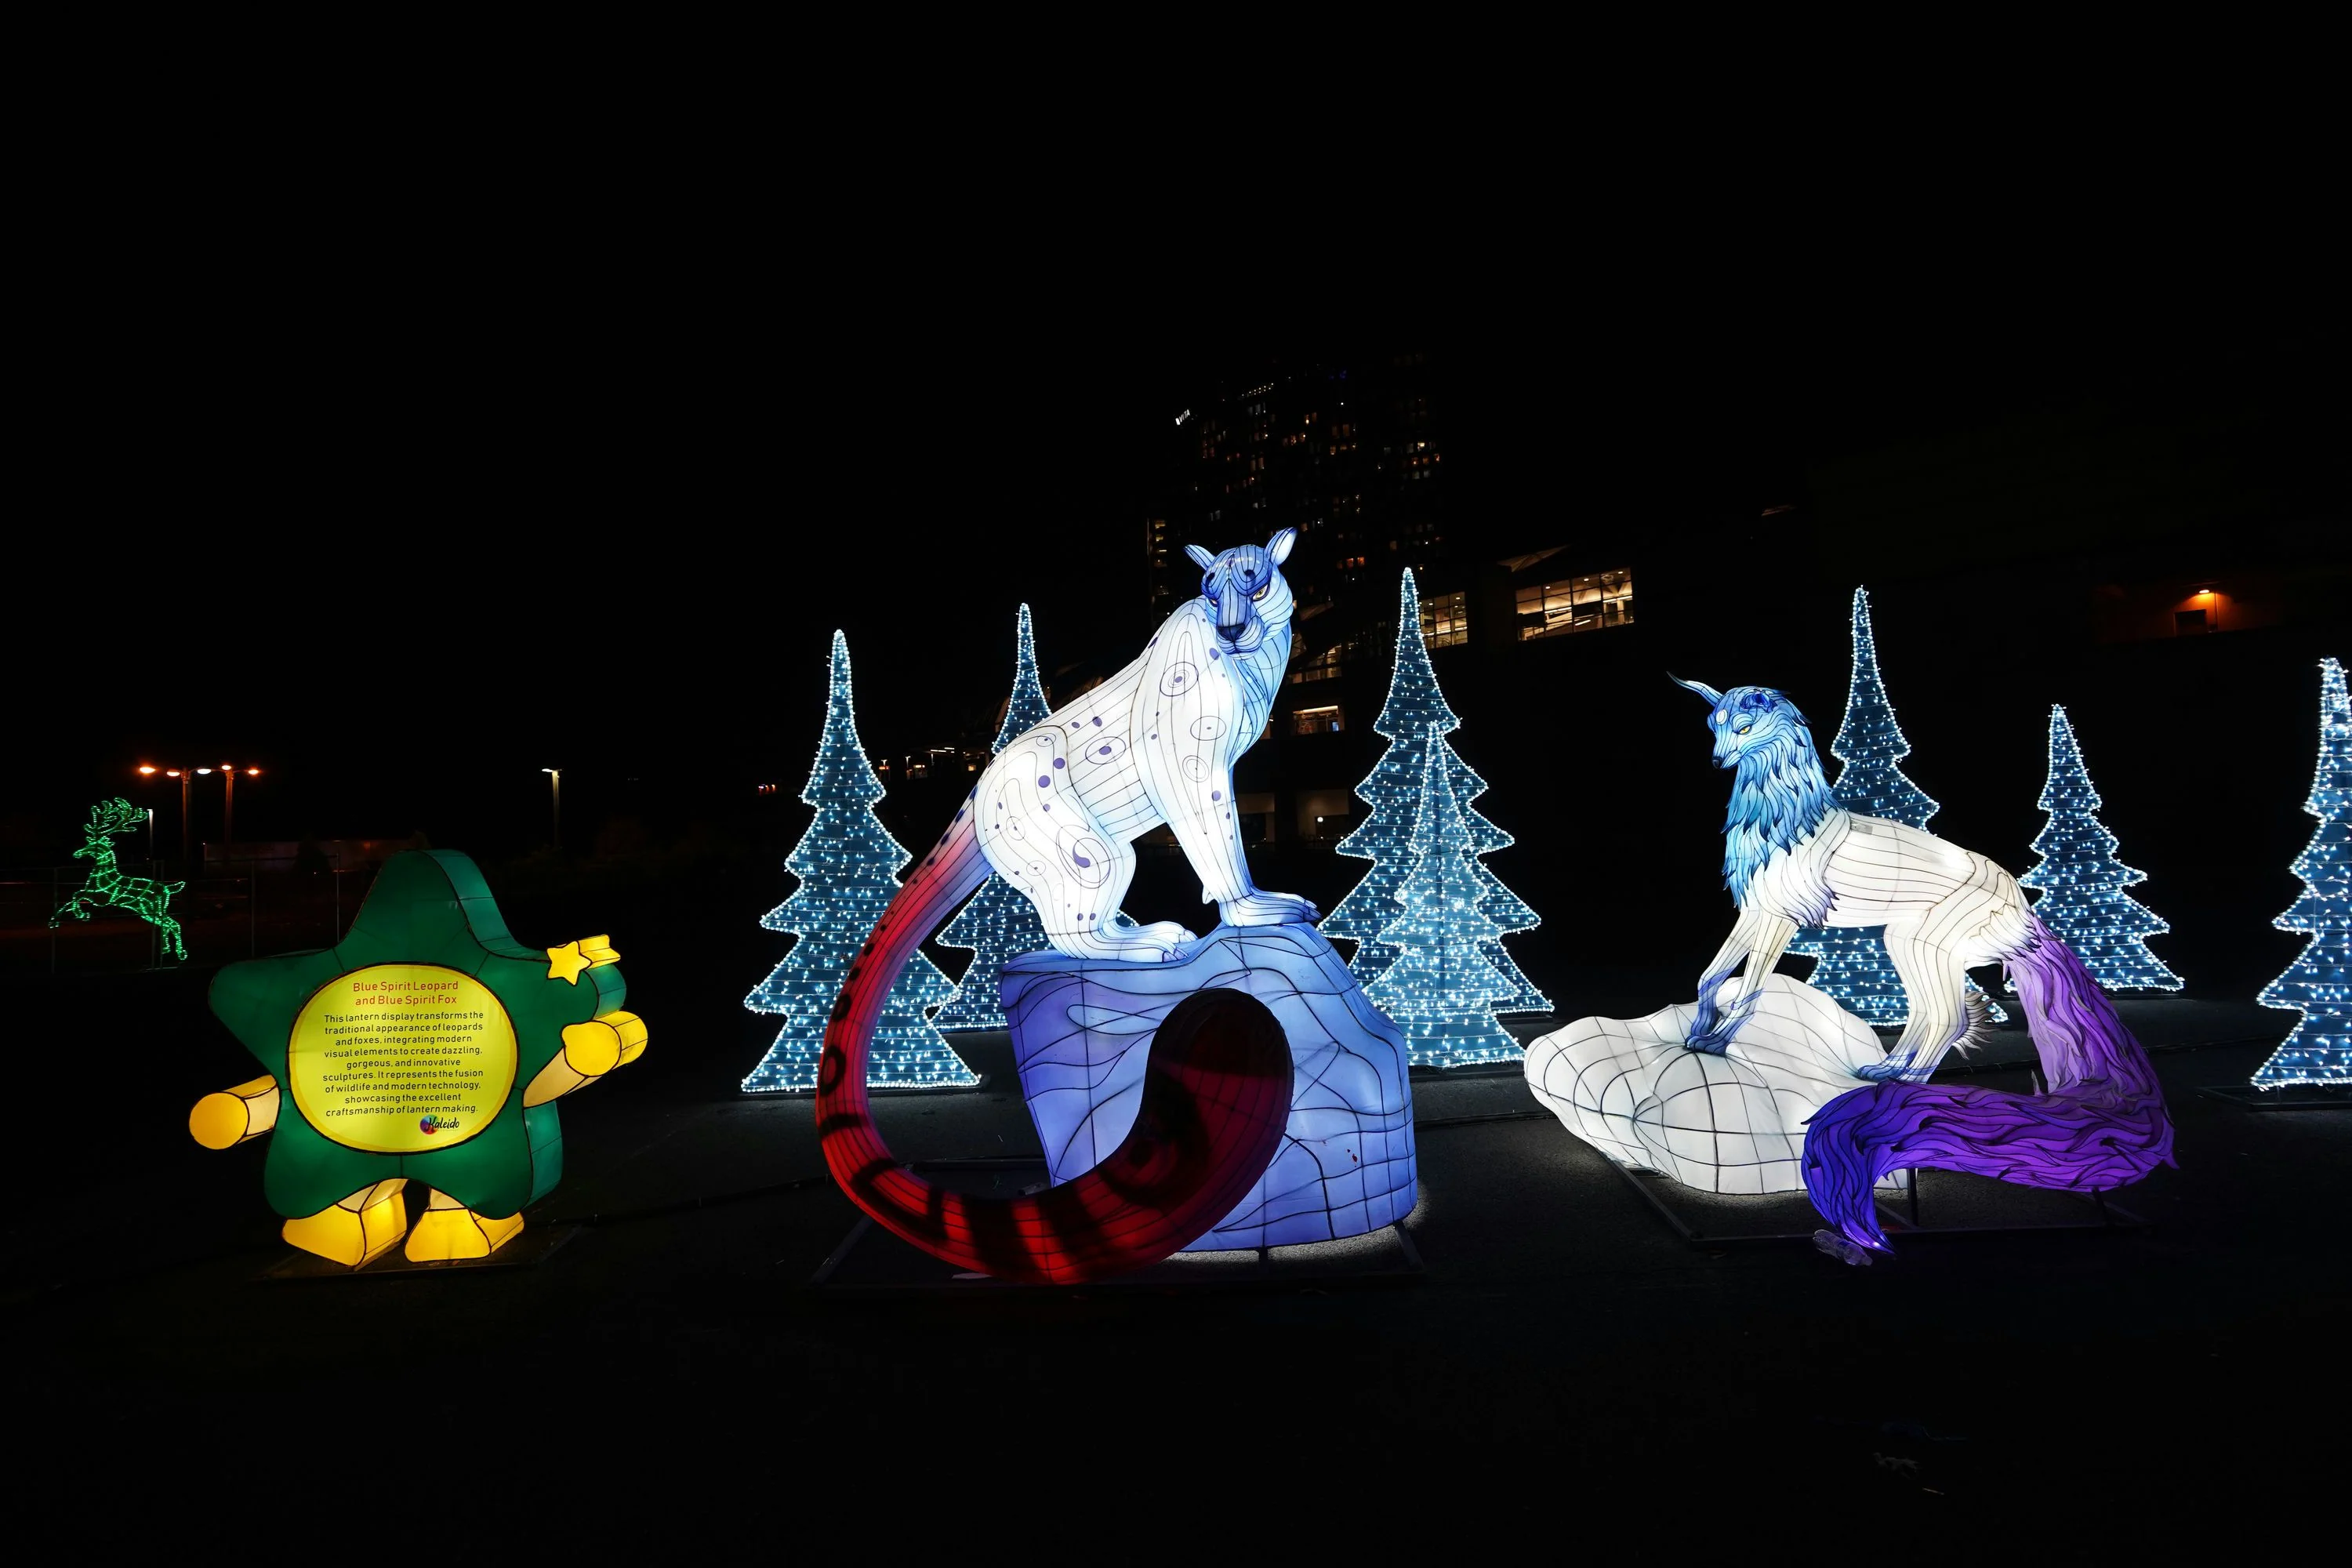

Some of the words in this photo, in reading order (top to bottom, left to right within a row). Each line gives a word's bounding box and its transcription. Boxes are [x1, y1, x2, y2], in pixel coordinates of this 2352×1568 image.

[354, 982, 378, 992] Blue
[380, 982, 410, 992] Spirit
[413, 981, 459, 992] Leopard
[356, 996, 375, 1005] and
[378, 996, 402, 1004] Blue
[405, 995, 435, 1006] Spirit
[437, 995, 457, 1004] Fox
[382, 1013, 414, 1022] display
[325, 1025, 374, 1034] traditional
[376, 1025, 430, 1033] appearance
[443, 1023, 483, 1032] leopards
[383, 1036, 435, 1045] integrating
[442, 1047, 483, 1055] dazzling,
[347, 1060, 393, 1070] gorgeous,
[322, 1072, 376, 1082] sculptures.
[386, 1071, 437, 1080] represents
[336, 1083, 370, 1092] wildlife
[345, 1095, 400, 1104] showcasing
[326, 1106, 394, 1116] craftsmanship
[443, 1105, 478, 1113] making.
[426, 1116, 459, 1130] Kaleido
